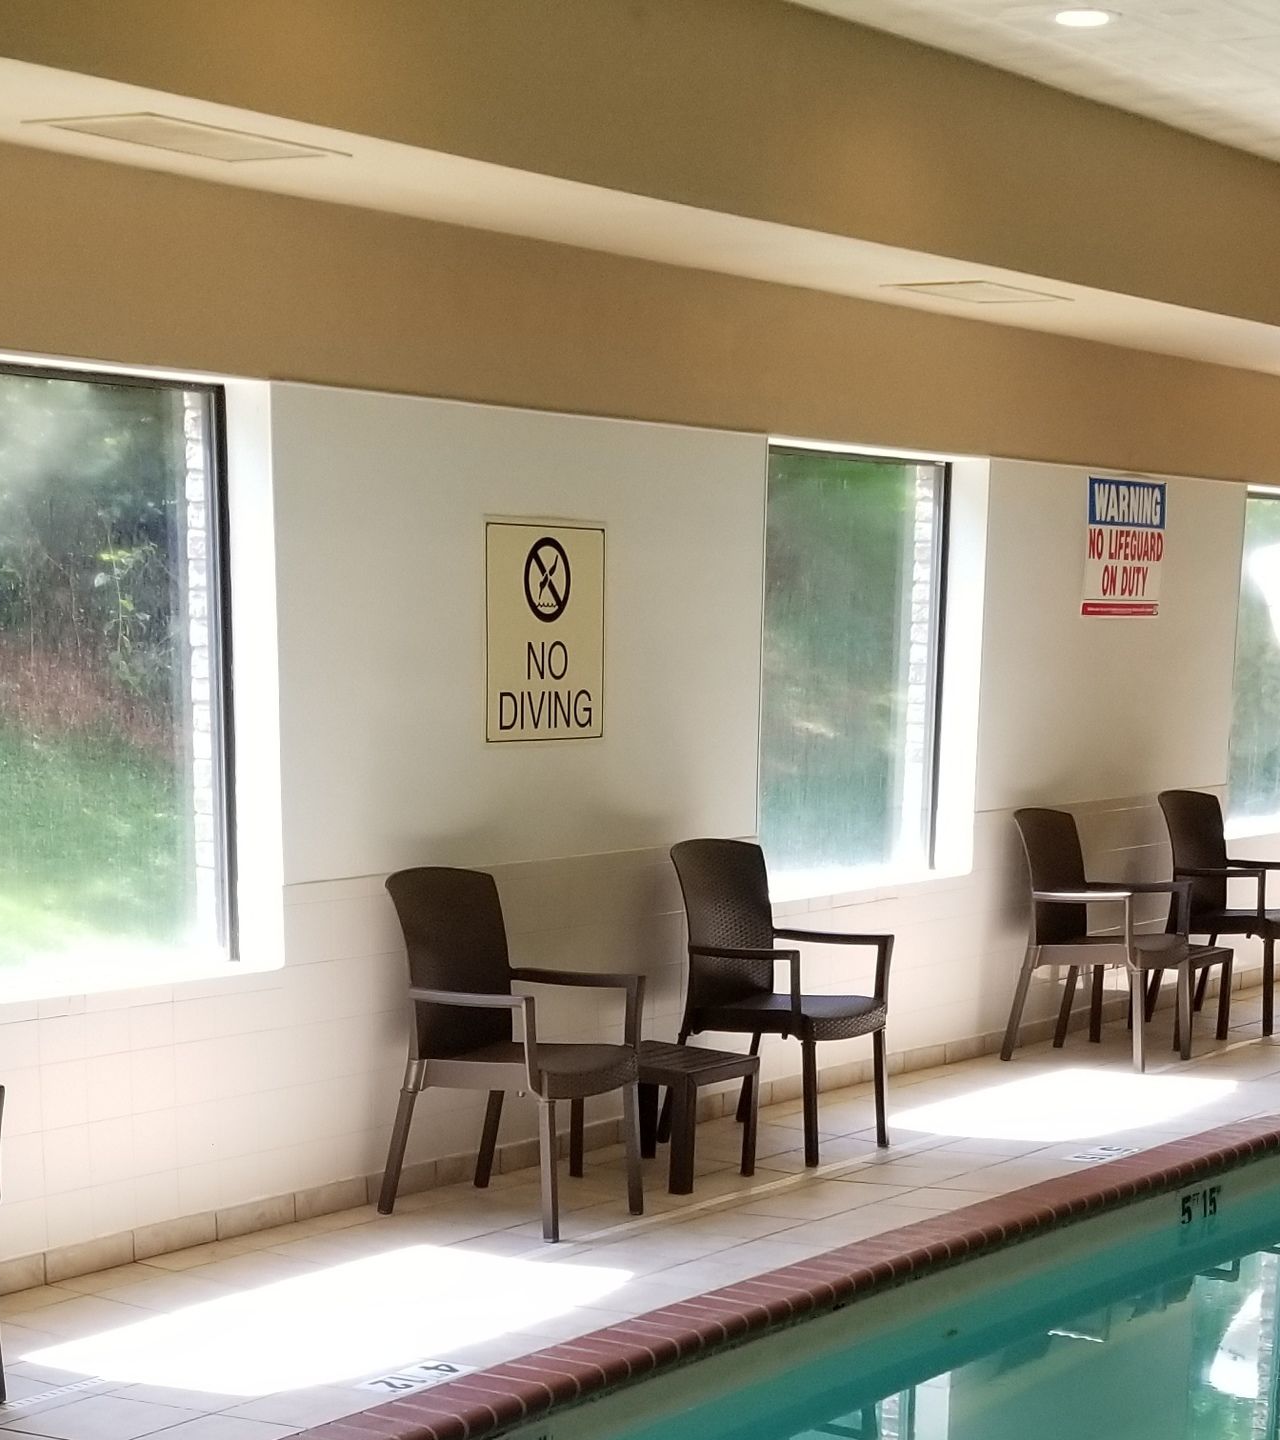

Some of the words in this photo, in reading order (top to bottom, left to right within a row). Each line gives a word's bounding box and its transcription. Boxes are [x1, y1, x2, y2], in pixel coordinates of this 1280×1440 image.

[1094, 483, 1161, 526] WARNING
[1088, 528, 1104, 560] NO
[1108, 529, 1164, 562] LIFEGUARD
[1101, 565, 1118, 597] ON
[1120, 566, 1149, 597] DUTY
[527, 640, 568, 681] NO
[498, 689, 593, 730] DIVING
[1181, 1194, 1192, 1224] 5
